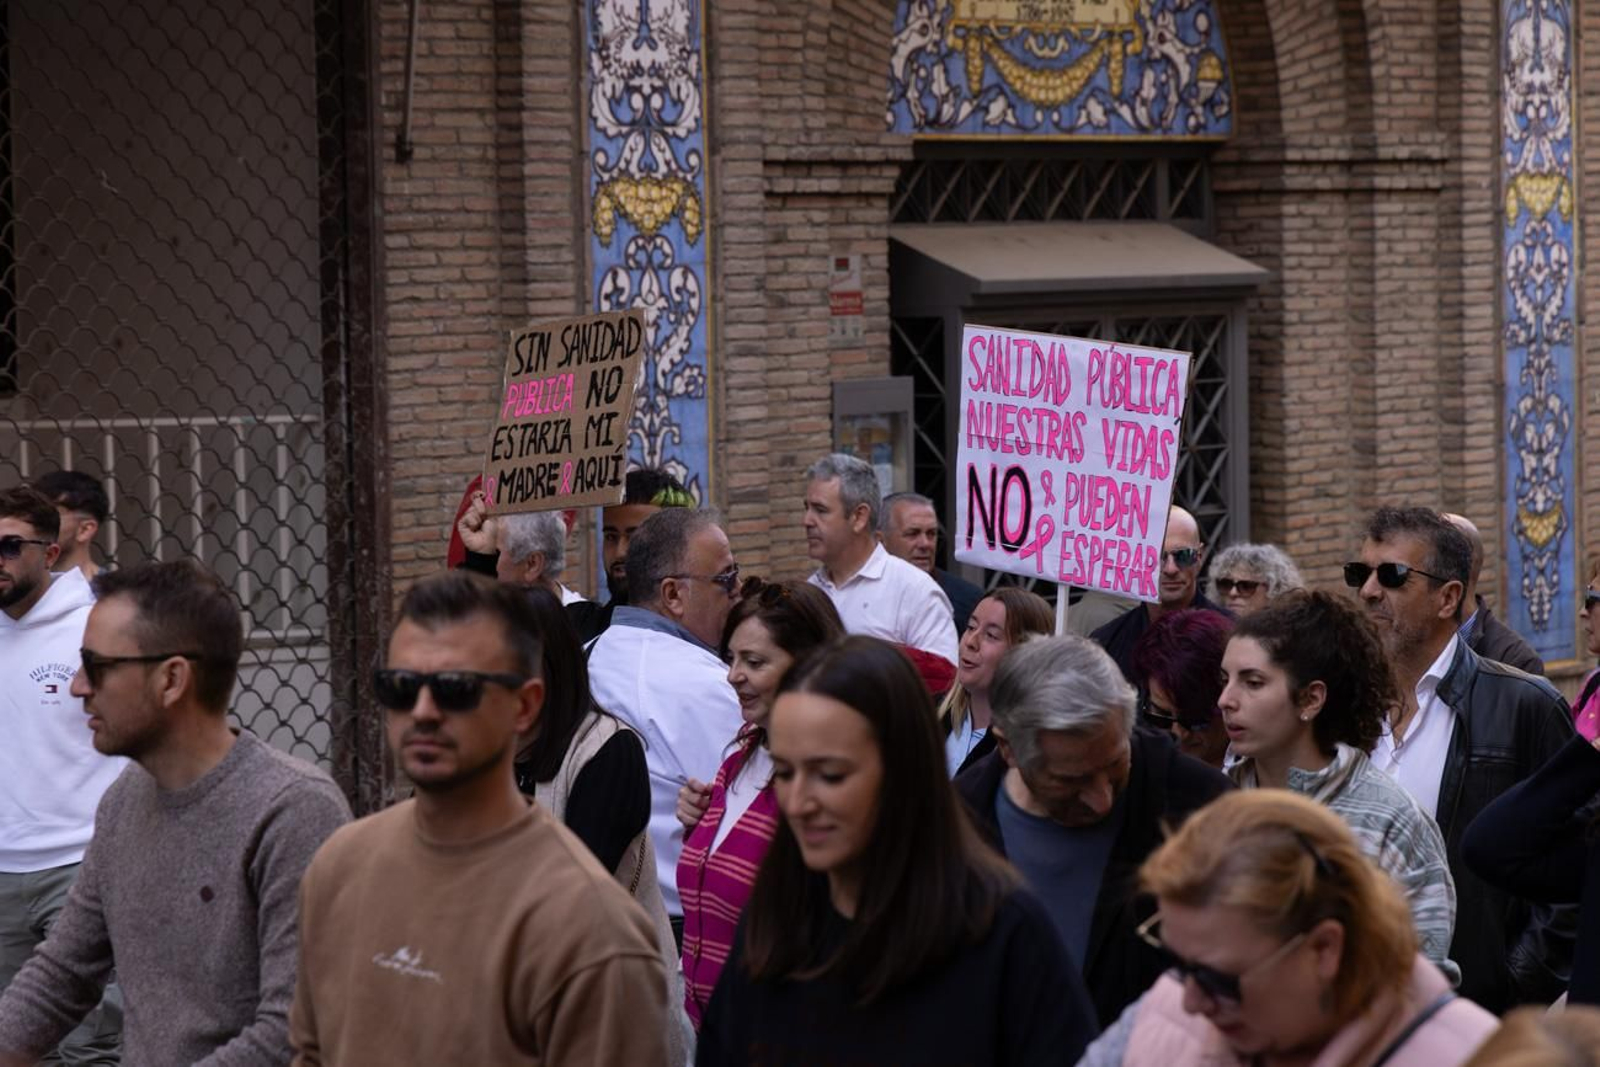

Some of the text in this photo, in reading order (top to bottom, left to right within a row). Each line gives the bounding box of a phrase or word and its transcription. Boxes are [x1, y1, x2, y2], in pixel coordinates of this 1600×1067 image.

[512, 316, 642, 376] SIN SANIDAD
[968, 334, 1072, 406] SANIDAD
[586, 366, 623, 409] NO
[491, 412, 619, 461] ESTARIA MI
[966, 399, 1175, 481] NUESTRAS VIDAS
[496, 444, 624, 504] MADRE AQUÍ
[966, 463, 1152, 553] NO PUEDEN
[1059, 530, 1159, 597] ESPERAR
